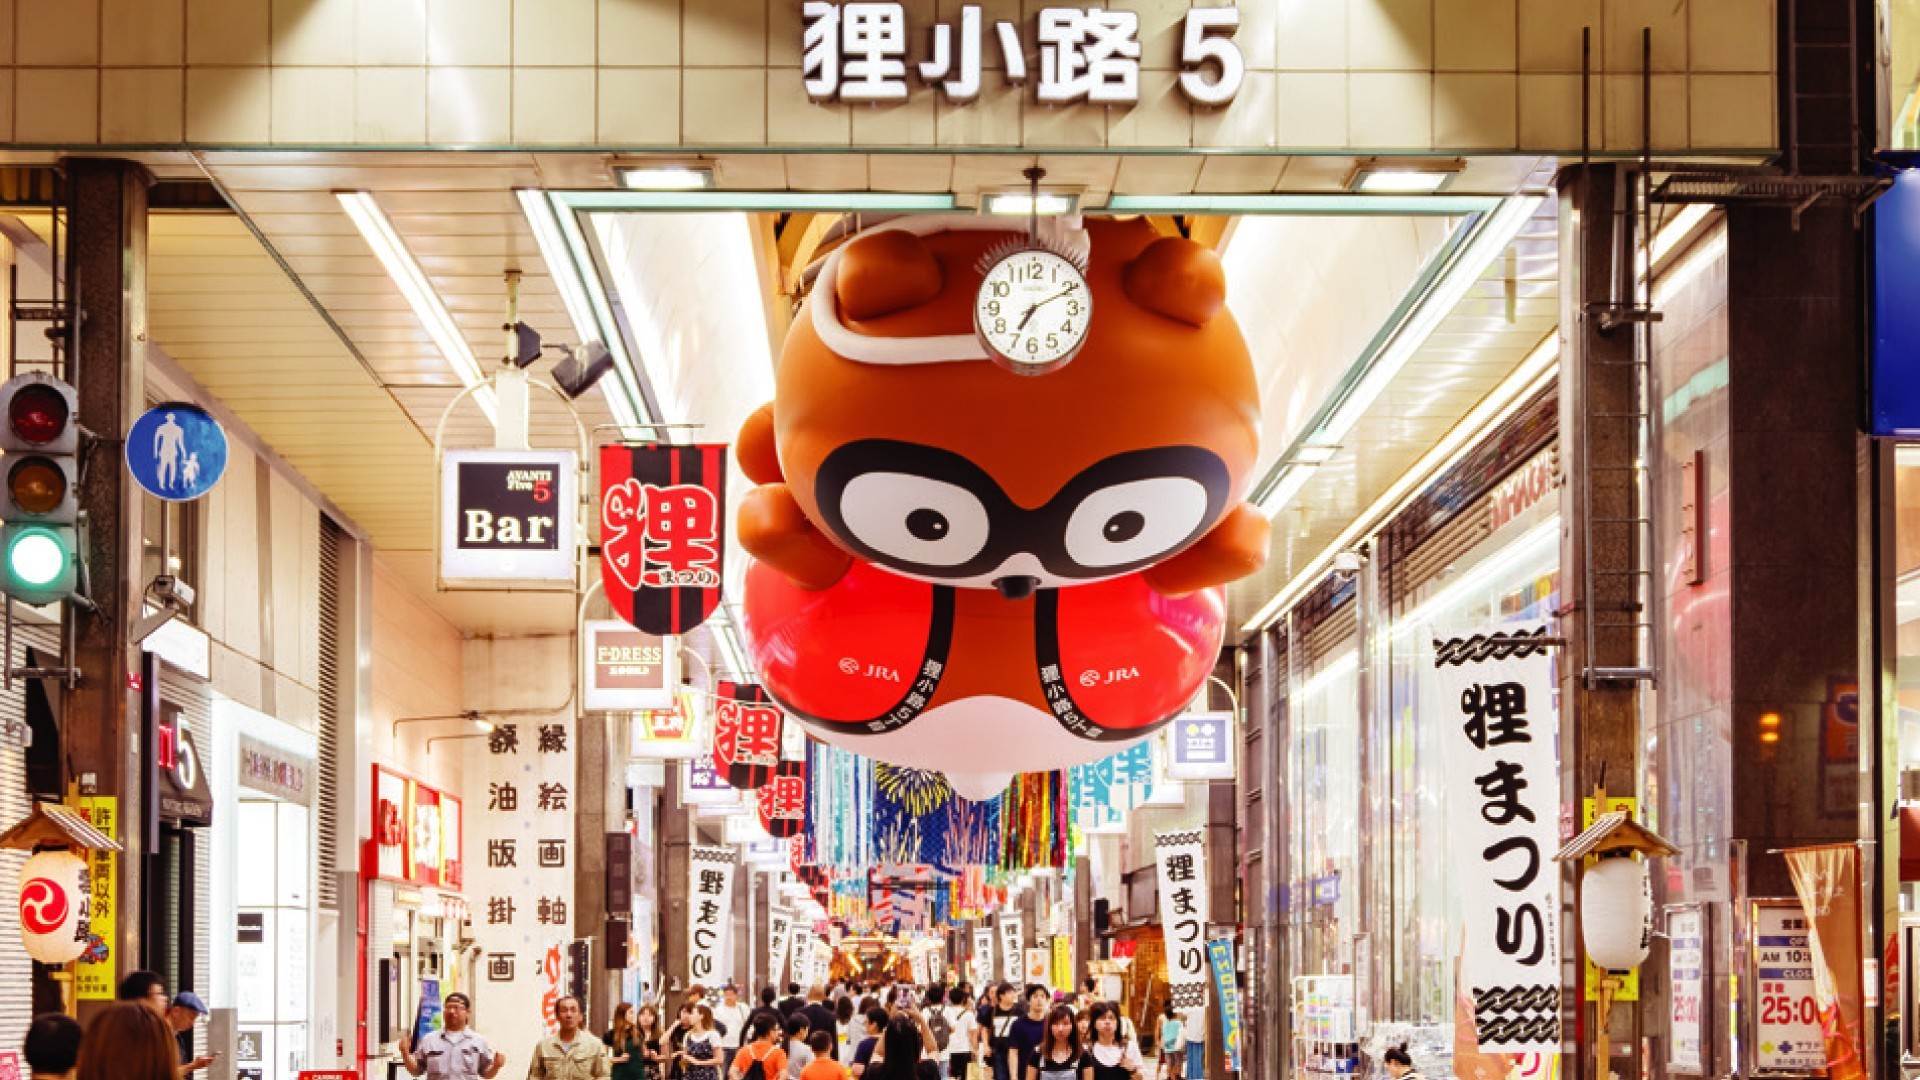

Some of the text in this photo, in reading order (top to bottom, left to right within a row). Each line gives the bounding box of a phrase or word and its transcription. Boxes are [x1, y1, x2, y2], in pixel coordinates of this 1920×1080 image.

[804, 2, 1244, 103] 狸小路 5
[1027, 263, 1042, 279] 12
[990, 281, 1009, 297] 10
[988, 301, 1000, 316] 9
[1067, 300, 1079, 316] 3
[995, 318, 1006, 333] 8
[1060, 319, 1072, 334] 4
[1010, 333, 1020, 348] 7
[1026, 337, 1038, 353] 6
[1046, 333, 1058, 348] 5
[533, 480, 552, 503] 5
[465, 509, 553, 543] Bar
[603, 478, 720, 591] 狸
[863, 664, 900, 682] JRA
[1104, 666, 1139, 685] JRA
[1461, 682, 1545, 966] 狸まつり
[1166, 853, 1202, 974] 狸まつり
[1761, 952, 1780, 963] AM
